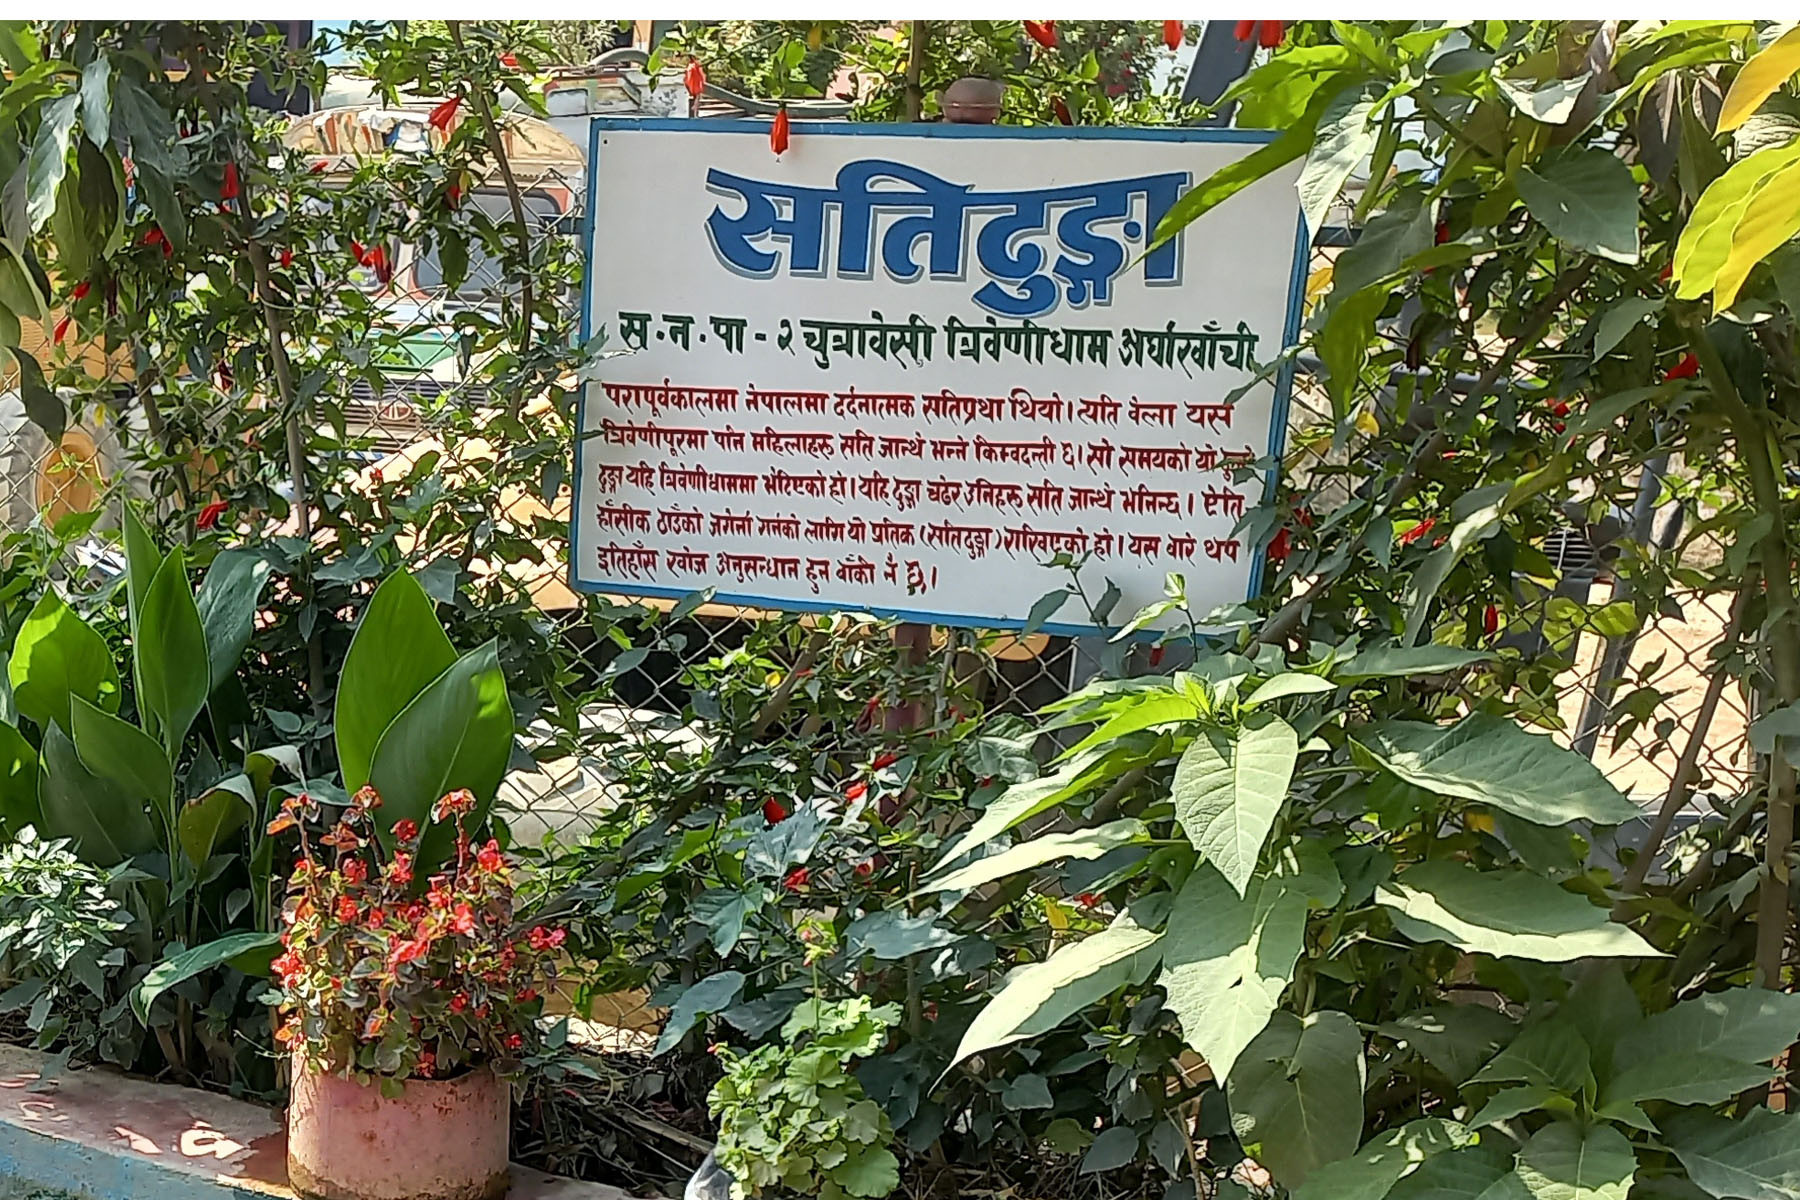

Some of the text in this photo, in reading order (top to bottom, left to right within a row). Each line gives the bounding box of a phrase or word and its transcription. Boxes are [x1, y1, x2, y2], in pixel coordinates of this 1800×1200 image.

[943, 315, 1114, 369] त्रिवेणीधाम
[745, 382, 830, 417] नेपालमा
[1185, 402, 1234, 434] यस
[710, 424, 746, 453] पनि
[838, 429, 876, 462] सति
[877, 431, 927, 460] जान्थे
[1086, 437, 1116, 476] सो
[1118, 441, 1193, 478] समयको
[1194, 442, 1218, 473] यो
[658, 461, 759, 495] त्रिवेणीधाममा
[761, 465, 827, 498] भेटिएको
[926, 474, 965, 513] चढेर
[1026, 478, 1065, 517] सति
[1067, 481, 1116, 513] जान्थे
[755, 512, 802, 541] गर्नको
[804, 516, 846, 544] लागि
[847, 516, 866, 544] यो
[1004, 523, 1089, 562] राखिएको
[1127, 531, 1162, 566] यस
[1204, 537, 1241, 564] थप
[665, 545, 710, 579] खोज
[715, 551, 801, 584] अनुसन्धान
[805, 557, 830, 595] हुन
[883, 551, 899, 586] नै
